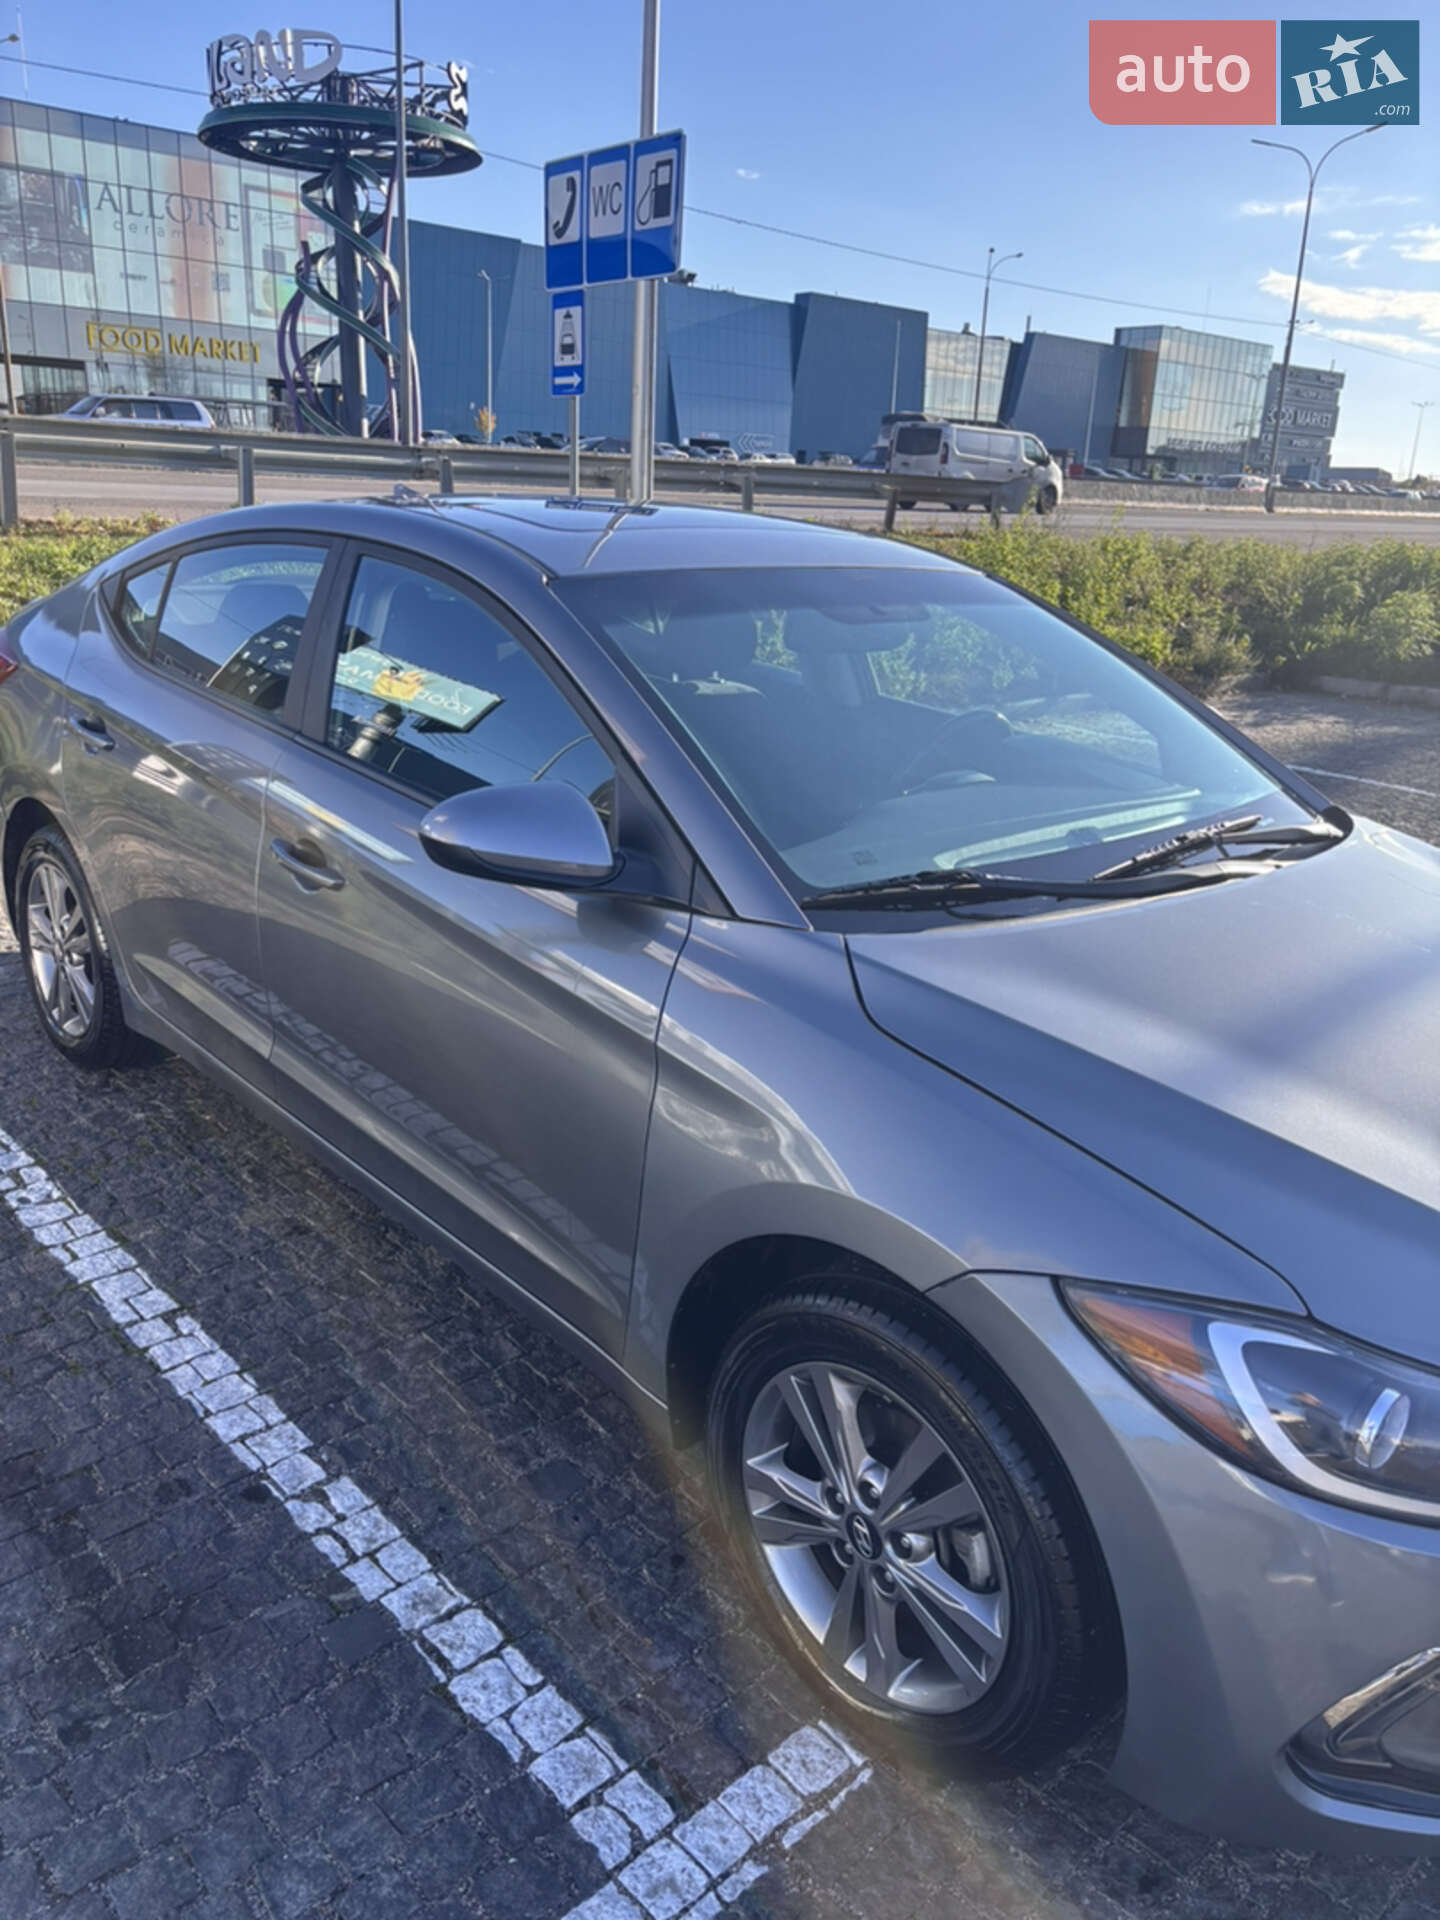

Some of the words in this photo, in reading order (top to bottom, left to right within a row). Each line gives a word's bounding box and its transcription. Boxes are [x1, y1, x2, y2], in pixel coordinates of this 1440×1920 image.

[592, 181, 623, 218] WC
[86, 321, 162, 355] FOOD
[168, 333, 261, 364] MARKET
